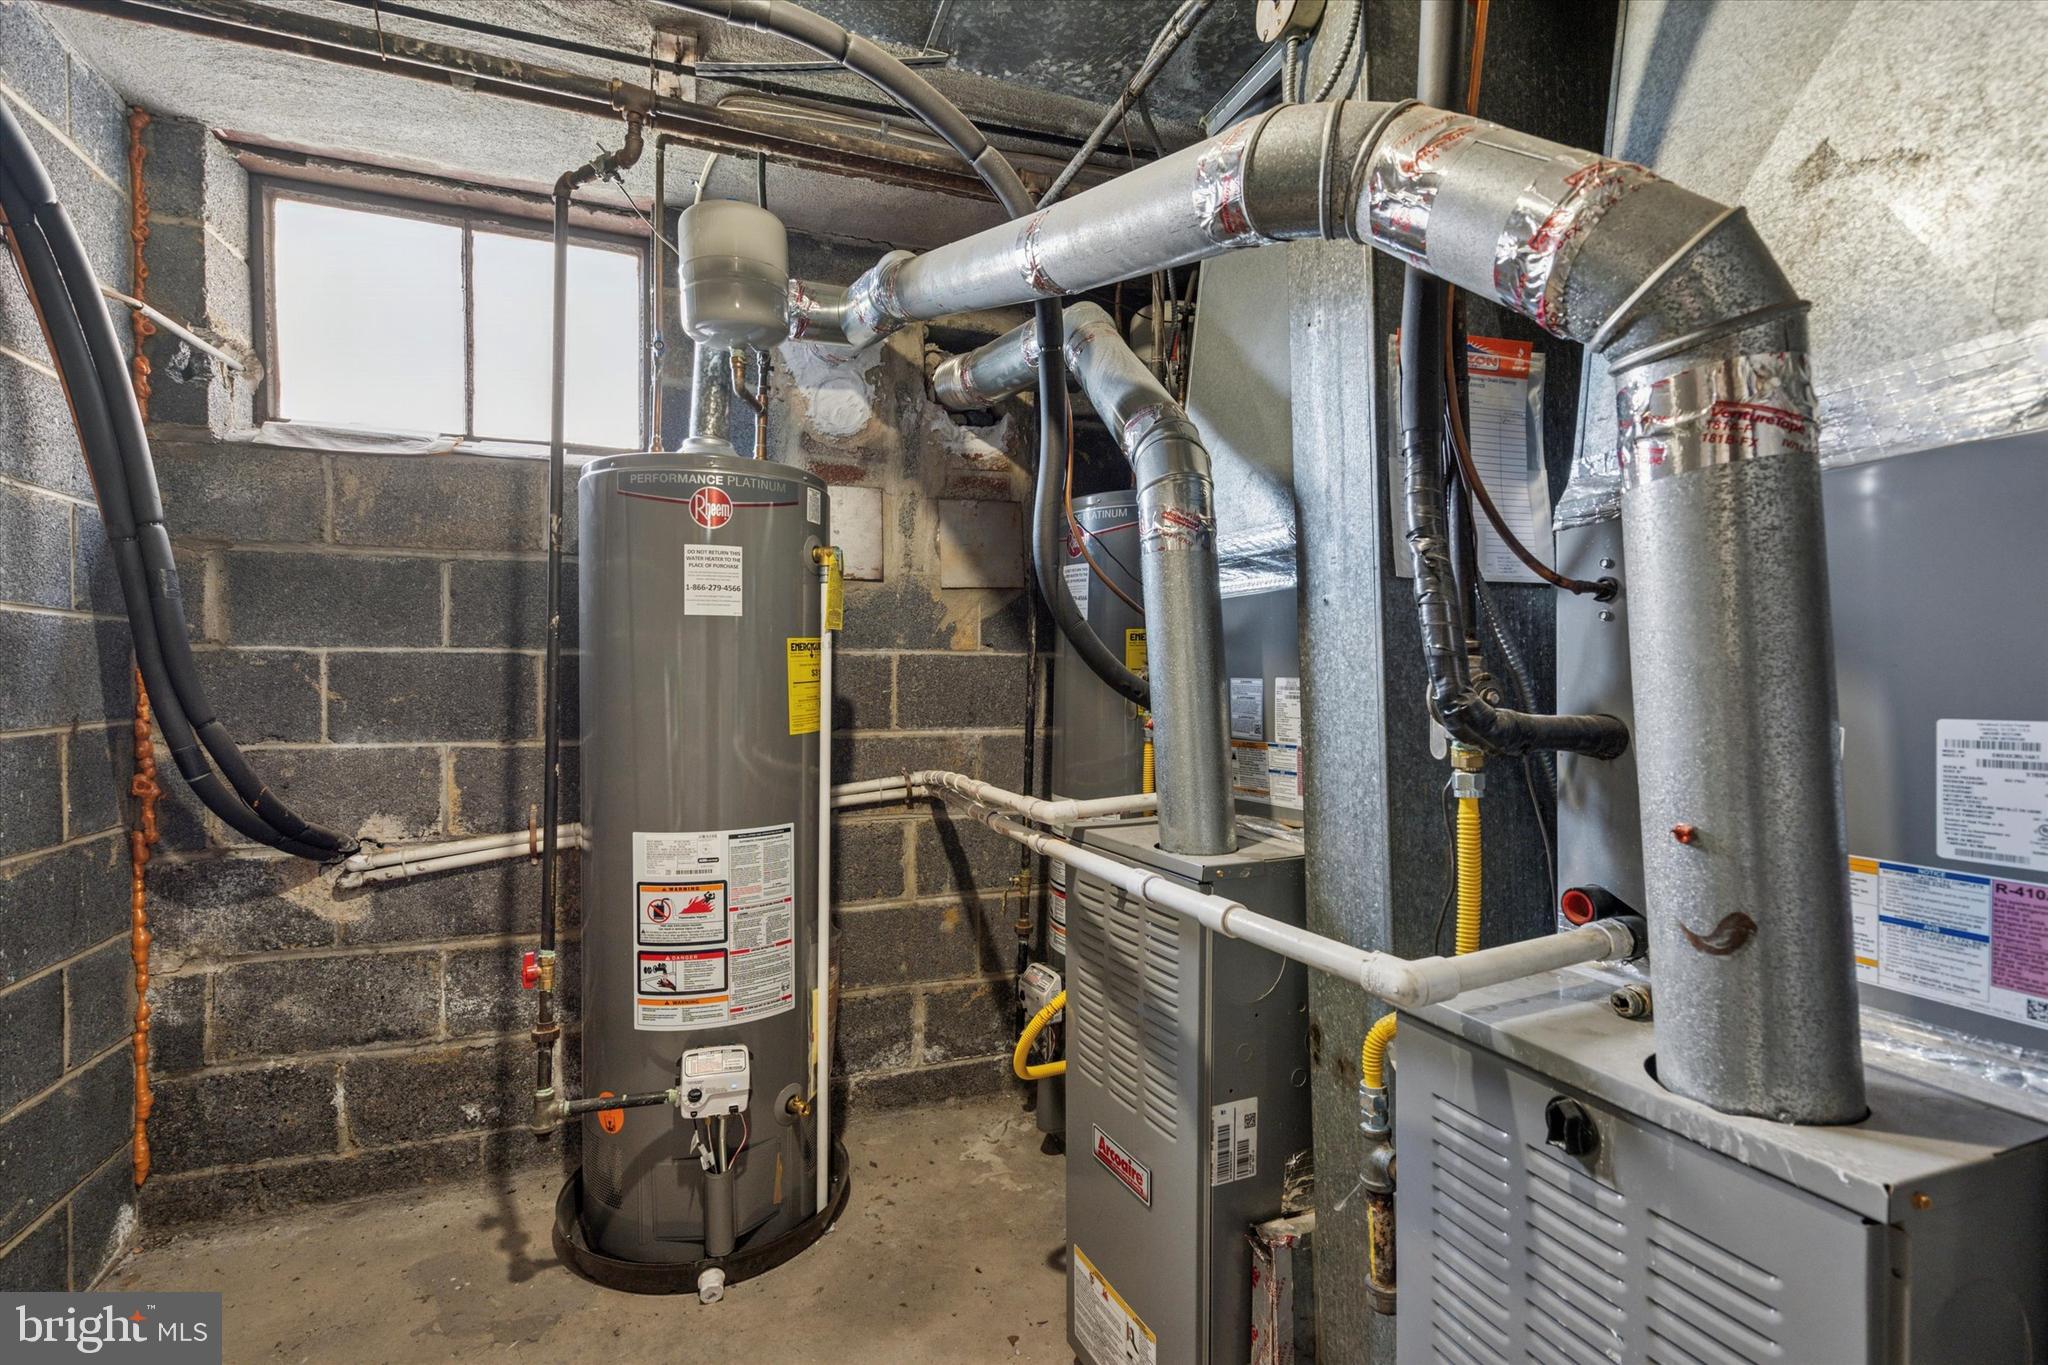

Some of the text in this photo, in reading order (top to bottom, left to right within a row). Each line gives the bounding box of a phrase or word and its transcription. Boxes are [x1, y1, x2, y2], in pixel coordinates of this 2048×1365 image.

[1711, 405, 1806, 435] VentureTape
[630, 473, 786, 493] PERFORMANCE PLATINUM
[695, 492, 730, 520] Rheem
[686, 583, 742, 592] 1-866-279-4566
[1918, 868, 1946, 878] NOTICE
[1995, 883, 2048, 900] R-410
[1098, 1135, 1144, 1186] Arcoaire
